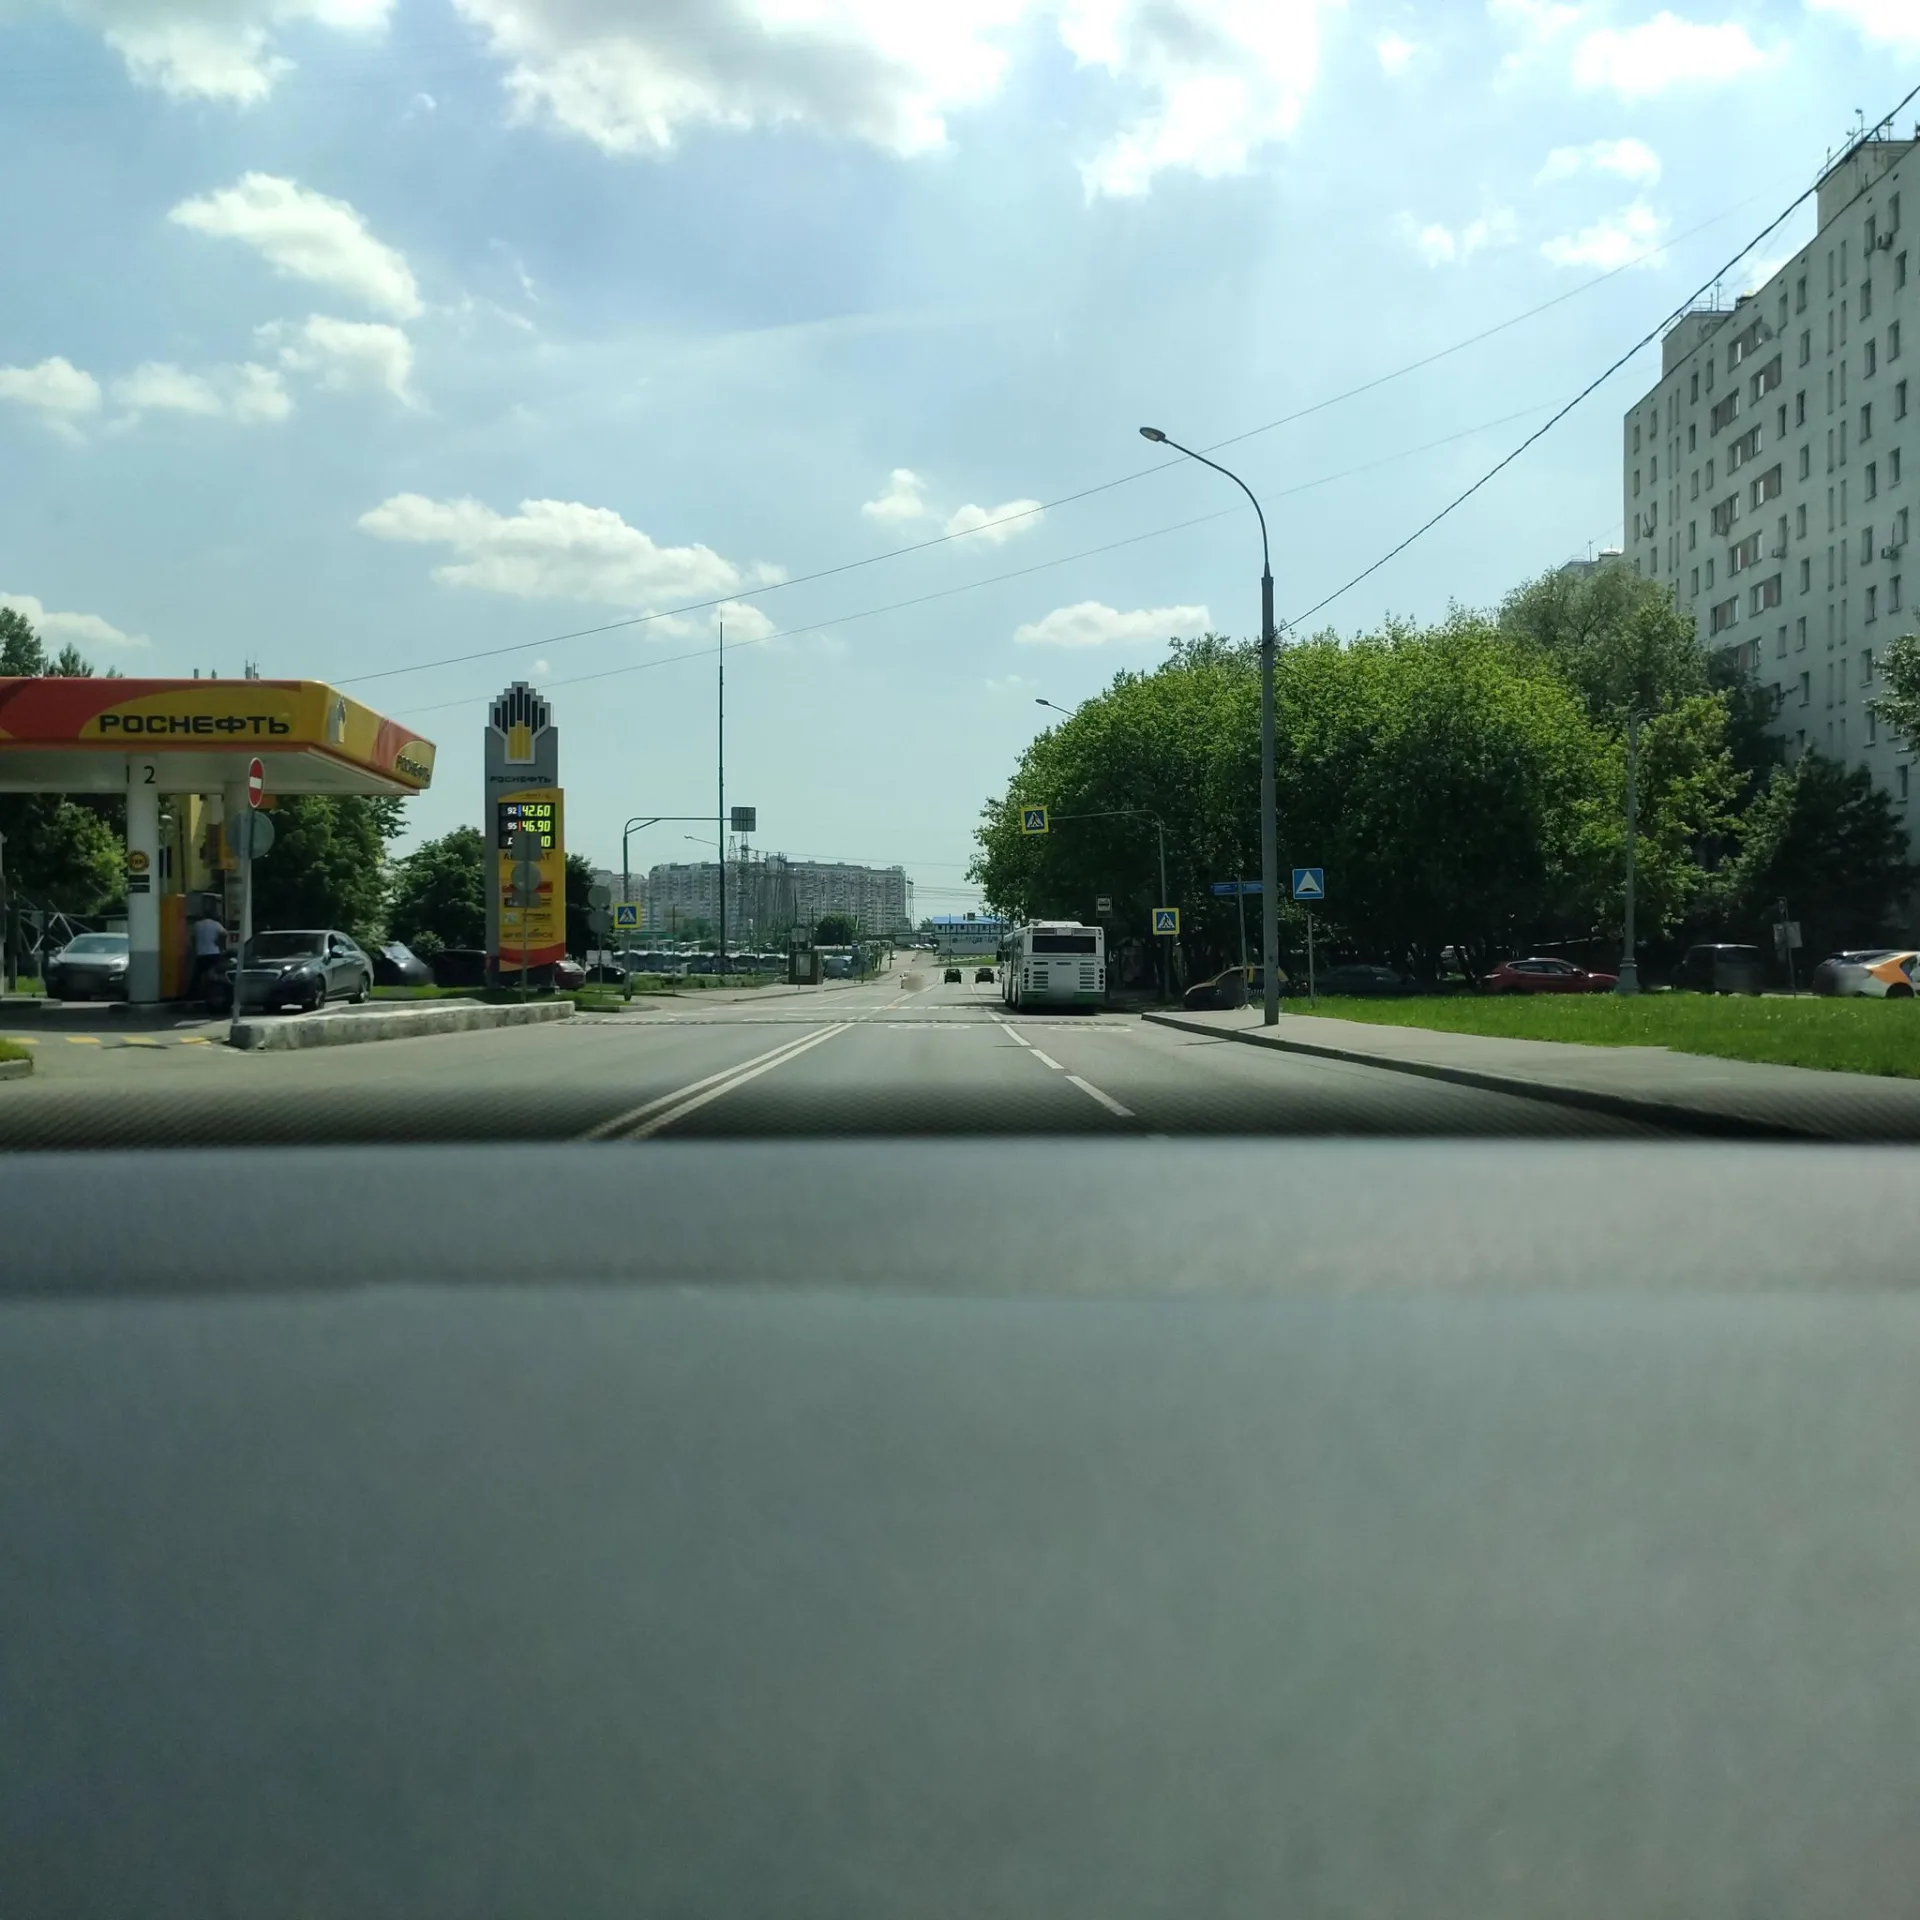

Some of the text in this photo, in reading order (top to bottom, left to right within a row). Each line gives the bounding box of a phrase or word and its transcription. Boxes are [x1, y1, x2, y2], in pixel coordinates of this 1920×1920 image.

[99, 714, 290, 735] РОСНЕФТЬ
[143, 765, 157, 784] 2
[490, 775, 552, 784] РОСНЕФТЬ
[507, 804, 551, 817] 92 42.60
[507, 820, 551, 832] 95 46.90
